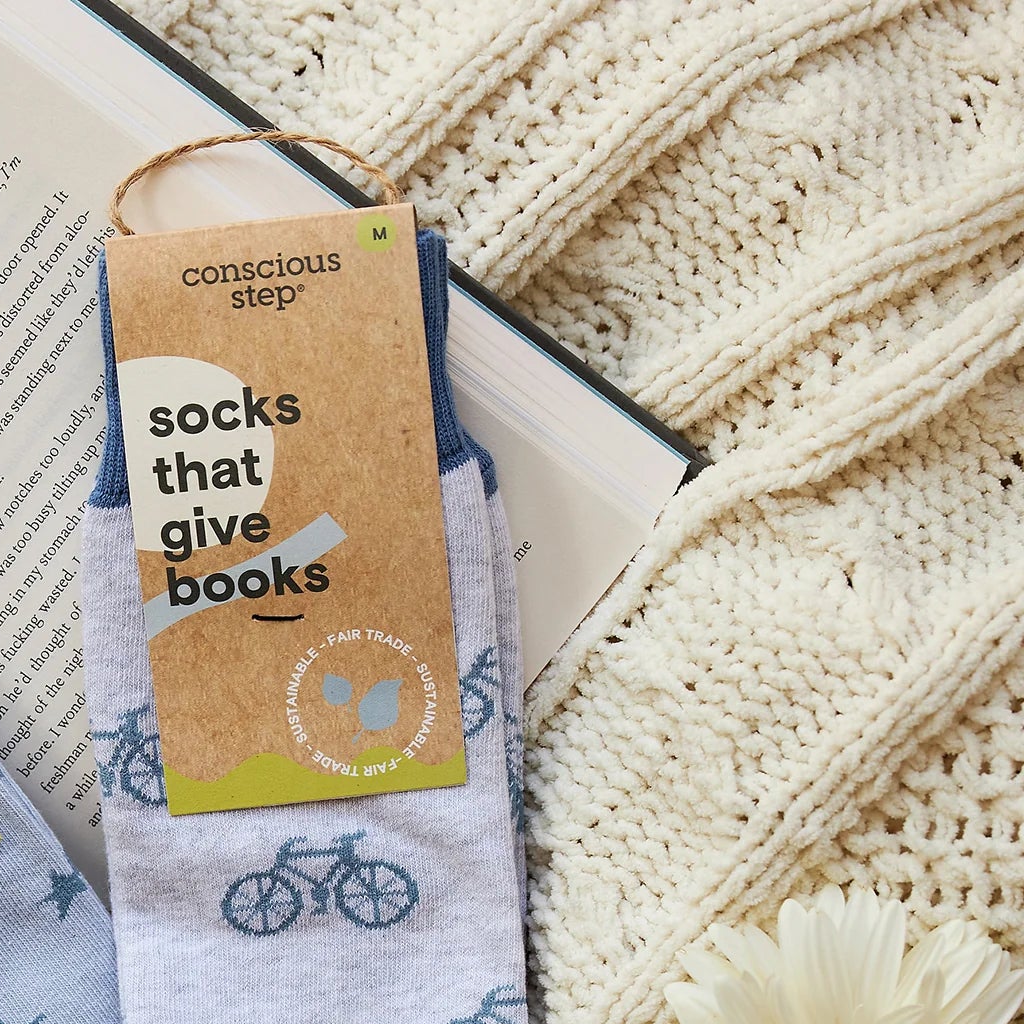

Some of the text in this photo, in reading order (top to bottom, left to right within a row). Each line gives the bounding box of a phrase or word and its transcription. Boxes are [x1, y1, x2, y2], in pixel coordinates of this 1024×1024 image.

[19, 204, 59, 253] opened.
[52, 190, 69, 205] It
[372, 227, 388, 241] M
[182, 252, 342, 287] conscious
[148, 386, 302, 437] socks
[3, 469, 42, 519] notches
[39, 447, 59, 469] too
[52, 402, 95, 447] loudly,
[152, 449, 263, 495] that
[8, 588, 26, 603] in
[22, 565, 43, 588] my
[39, 514, 81, 566] stomach
[160, 506, 271, 562] give
[166, 556, 330, 606] books
[0, 613, 44, 661] fucking
[38, 568, 77, 612] wasted.
[34, 694, 48, 713] of
[44, 677, 65, 698] the
[286, 629, 437, 777] FAIR TRADE SUSTAINABLE FAIR TRADE SUSTAINABLE
[15, 740, 54, 777] before.
[39, 742, 87, 794] freshman
